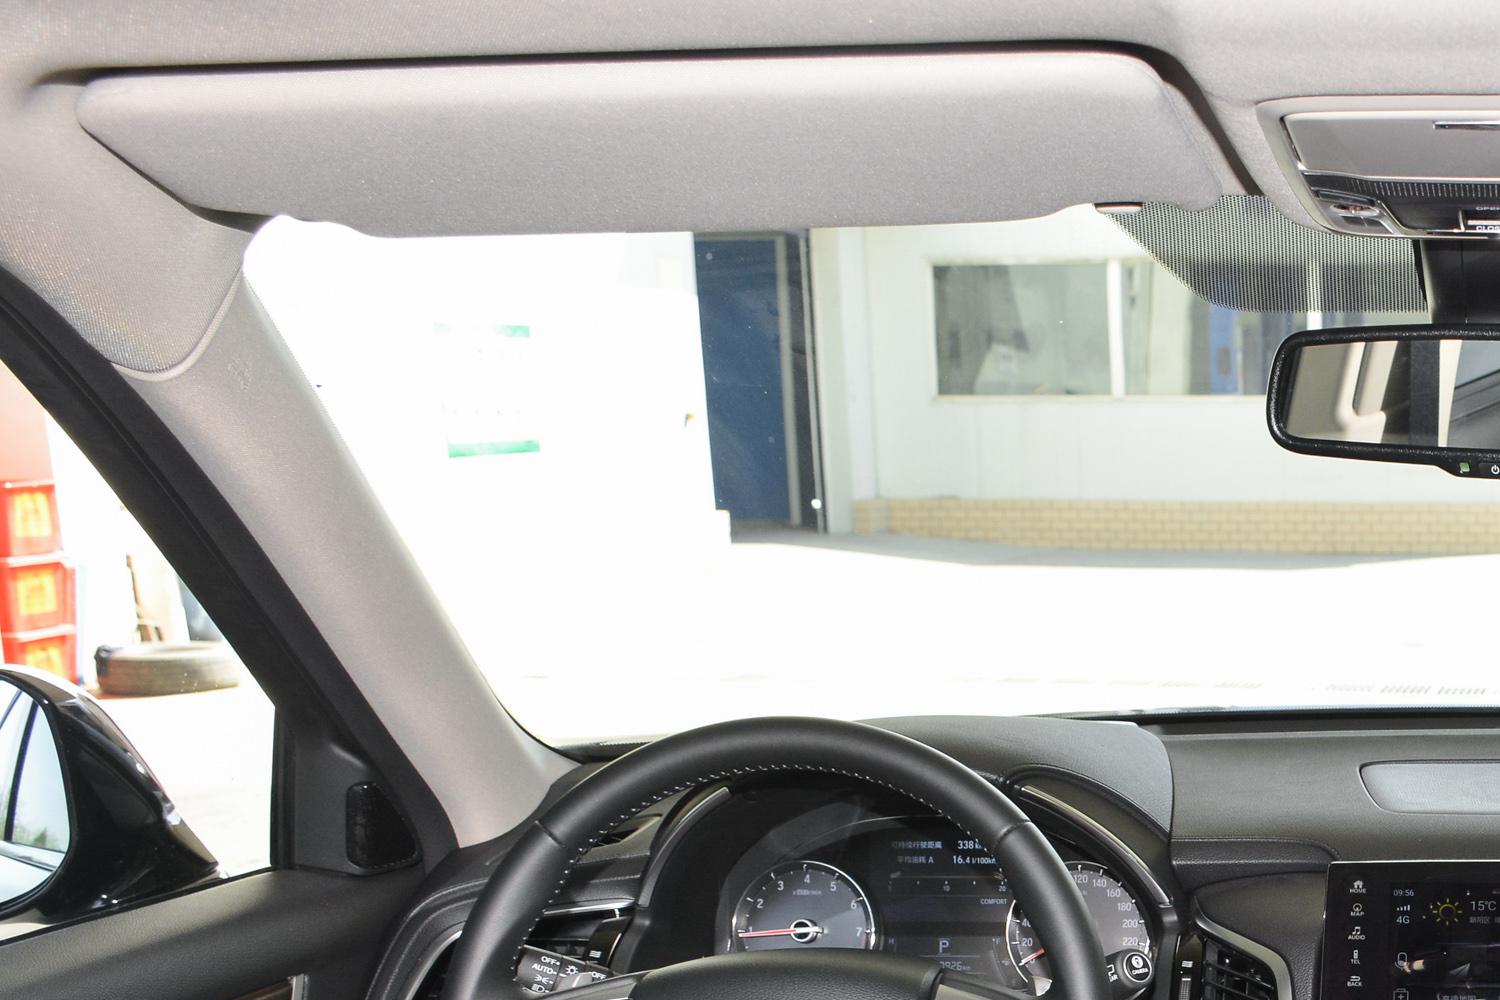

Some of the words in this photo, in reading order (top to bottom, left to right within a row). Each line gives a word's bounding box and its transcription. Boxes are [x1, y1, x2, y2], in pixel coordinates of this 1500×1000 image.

[957, 840, 974, 850] 338
[928, 856, 935, 864] A
[953, 856, 970, 864] 16.4
[804, 874, 811, 884] 4
[1073, 874, 1088, 884] 120
[1092, 879, 1107, 888] 140
[777, 880, 784, 891] 3
[829, 881, 837, 892] 5
[1106, 888, 1121, 898] 160
[1393, 889, 1415, 897] 09:56
[756, 898, 764, 909] 2
[850, 900, 857, 910] 6
[1117, 902, 1132, 911] 180
[1122, 919, 1138, 928] 200
[1396, 916, 1410, 924] 4G
[855, 927, 863, 937] 7
[939, 939, 950, 953] P
[1022, 937, 1033, 946] 20
[1122, 937, 1138, 946] 220
[541, 956, 557, 965] OFF
[532, 963, 554, 975] AUTO
[591, 971, 607, 980] OFF
